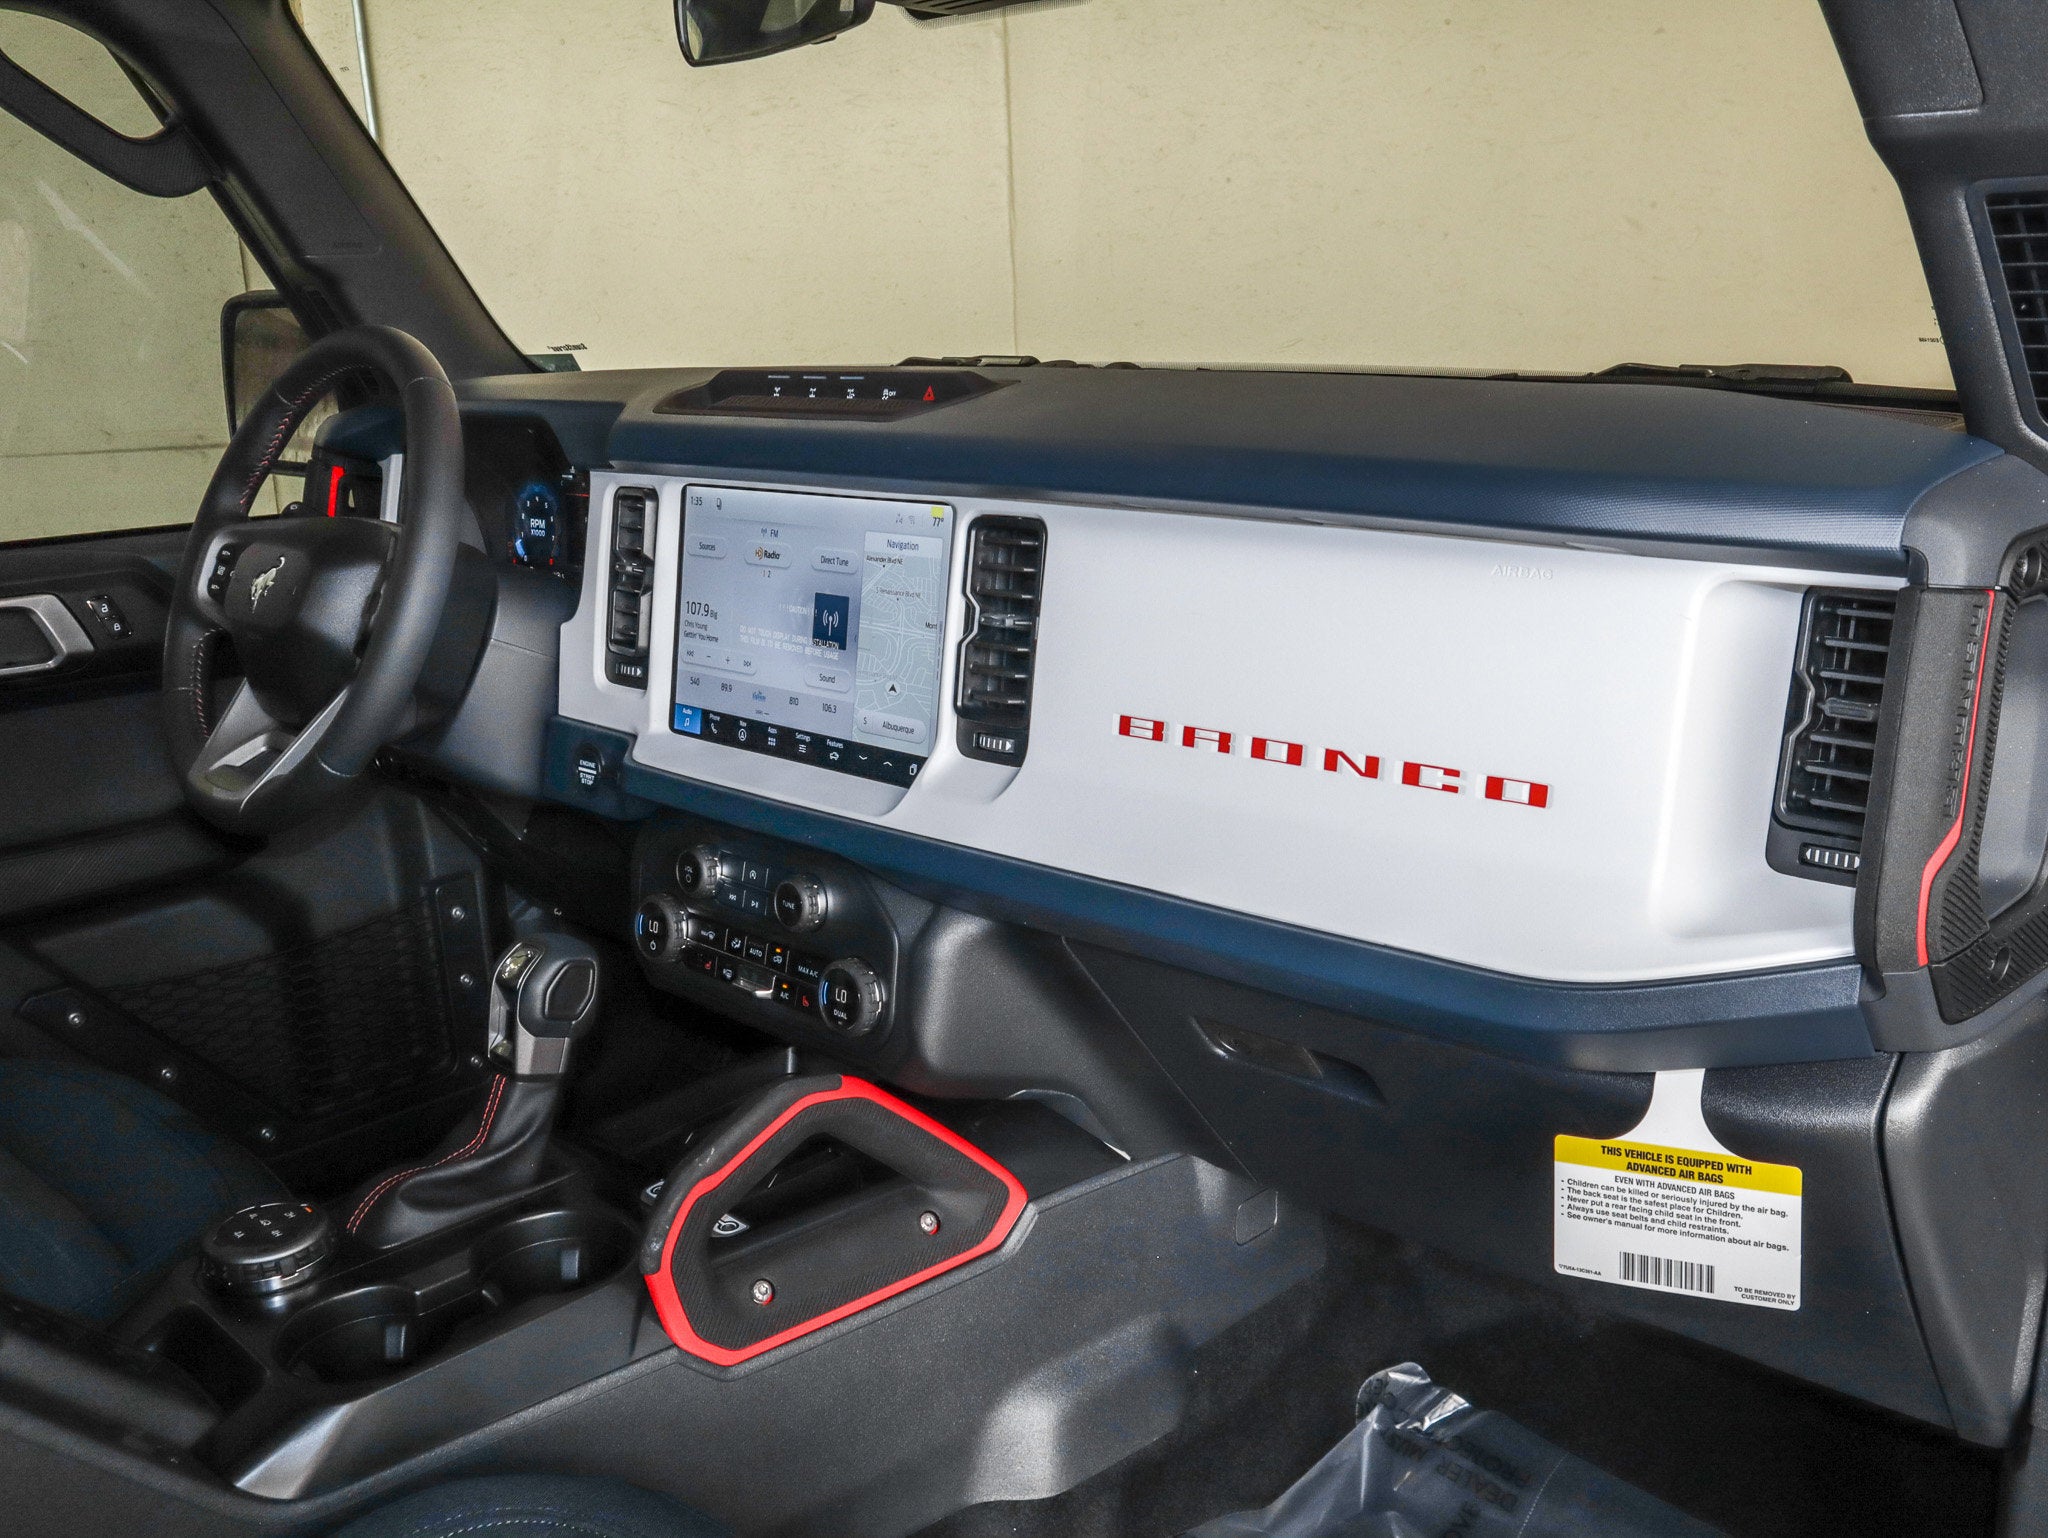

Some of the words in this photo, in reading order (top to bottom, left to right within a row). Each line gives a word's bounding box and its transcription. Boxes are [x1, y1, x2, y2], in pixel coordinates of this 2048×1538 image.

[690, 496, 703, 506] 1:35
[530, 518, 546, 530] RPM
[770, 529, 779, 538] FM
[698, 542, 716, 552] Sources
[886, 539, 920, 552] Navigation
[763, 550, 781, 560] Radio
[820, 555, 835, 566] Direct
[836, 557, 850, 567] Tune
[1490, 564, 1553, 581] AIRBAG
[686, 601, 710, 617] 107.9
[684, 619, 695, 629] Chris
[695, 621, 708, 631] Young
[706, 635, 718, 643] Home
[690, 676, 700, 687] 540
[819, 673, 836, 684] Sound
[720, 682, 733, 693] 89.9
[682, 707, 693, 716] Audio
[822, 702, 837, 714] 106.3
[709, 713, 720, 722] Phone
[767, 726, 778, 735] Apps
[882, 720, 915, 736] Albuquerque
[795, 732, 811, 743] Settings
[826, 739, 844, 750] Features
[579, 759, 596, 769] ENGINE
[1114, 713, 1552, 809] BRONCO
[579, 772, 595, 781] START
[782, 899, 796, 911] TUNE
[648, 919, 659, 934] LO
[749, 947, 763, 958] AUTO
[798, 965, 809, 976] MAX
[809, 967, 819, 979] A/C
[780, 991, 790, 1001] A/C
[835, 987, 848, 1004] LO
[833, 1009, 848, 1020] DUAL
[1601, 1145, 1622, 1157] THIS
[1624, 1148, 1662, 1163] VEHICLE
[1665, 1154, 1674, 1164] IS
[1677, 1156, 1724, 1172] EQUIPPED
[1726, 1162, 1753, 1176] WITH
[1626, 1161, 1676, 1177] ADVANCED
[1679, 1168, 1695, 1180] AIR
[1697, 1171, 1724, 1184] BAGS
[1614, 1175, 1634, 1186] EVEN
[1635, 1178, 1655, 1189] WITH
[1656, 1181, 1697, 1195] ADVANCED
[1698, 1186, 1712, 1197] AIR
[1714, 1189, 1735, 1200] BAGS
[1567, 1178, 1599, 1190] Children
[1600, 1184, 1615, 1192] can
[1616, 1184, 1626, 1194] be
[1628, 1187, 1649, 1198] killed
[1650, 1191, 1659, 1199] or
[1661, 1193, 1697, 1206] seriously
[1699, 1197, 1728, 1209] injured
[1729, 1202, 1740, 1212] by
[1742, 1204, 1755, 1213] the
[1757, 1206, 1769, 1215] air
[1770, 1207, 1789, 1219] bag.
[1567, 1186, 1582, 1196] The
[1583, 1188, 1601, 1199] back
[1603, 1192, 1620, 1202] seat
[1621, 1193, 1628, 1203] is
[1630, 1195, 1642, 1205] the
[1644, 1198, 1668, 1209] safest
[1669, 1202, 1691, 1213] place
[1693, 1205, 1704, 1214] for
[1706, 1207, 1743, 1220] Children.
[1567, 1195, 1589, 1205] Never
[1590, 1198, 1603, 1209] put
[1611, 1202, 1627, 1211] rear
[1629, 1204, 1653, 1216] facing
[1655, 1207, 1674, 1219] child
[1676, 1212, 1693, 1222] seat
[1695, 1214, 1703, 1223] in
[1704, 1216, 1717, 1225] the
[1719, 1217, 1741, 1228] front.
[1567, 1203, 1594, 1215] Always
[1596, 1208, 1610, 1217] use
[1611, 1210, 1628, 1219] seat
[1630, 1212, 1649, 1223] belts
[1650, 1215, 1666, 1226] and
[1667, 1217, 1687, 1229] child
[1688, 1222, 1729, 1235] restraints.
[1567, 1211, 1581, 1220] See
[1583, 1215, 1612, 1225] owner's
[1614, 1219, 1642, 1231] manual
[1644, 1223, 1655, 1233] for
[1657, 1227, 1677, 1236] more
[1679, 1229, 1725, 1244] information
[1727, 1235, 1751, 1246] about
[1753, 1239, 1765, 1248] air
[1766, 1240, 1789, 1252] bags.
[1741, 1293, 1777, 1303] CUSTOMER
[1777, 1298, 1795, 1306] ONLY
[1754, 1289, 1786, 1299] REMOVED
